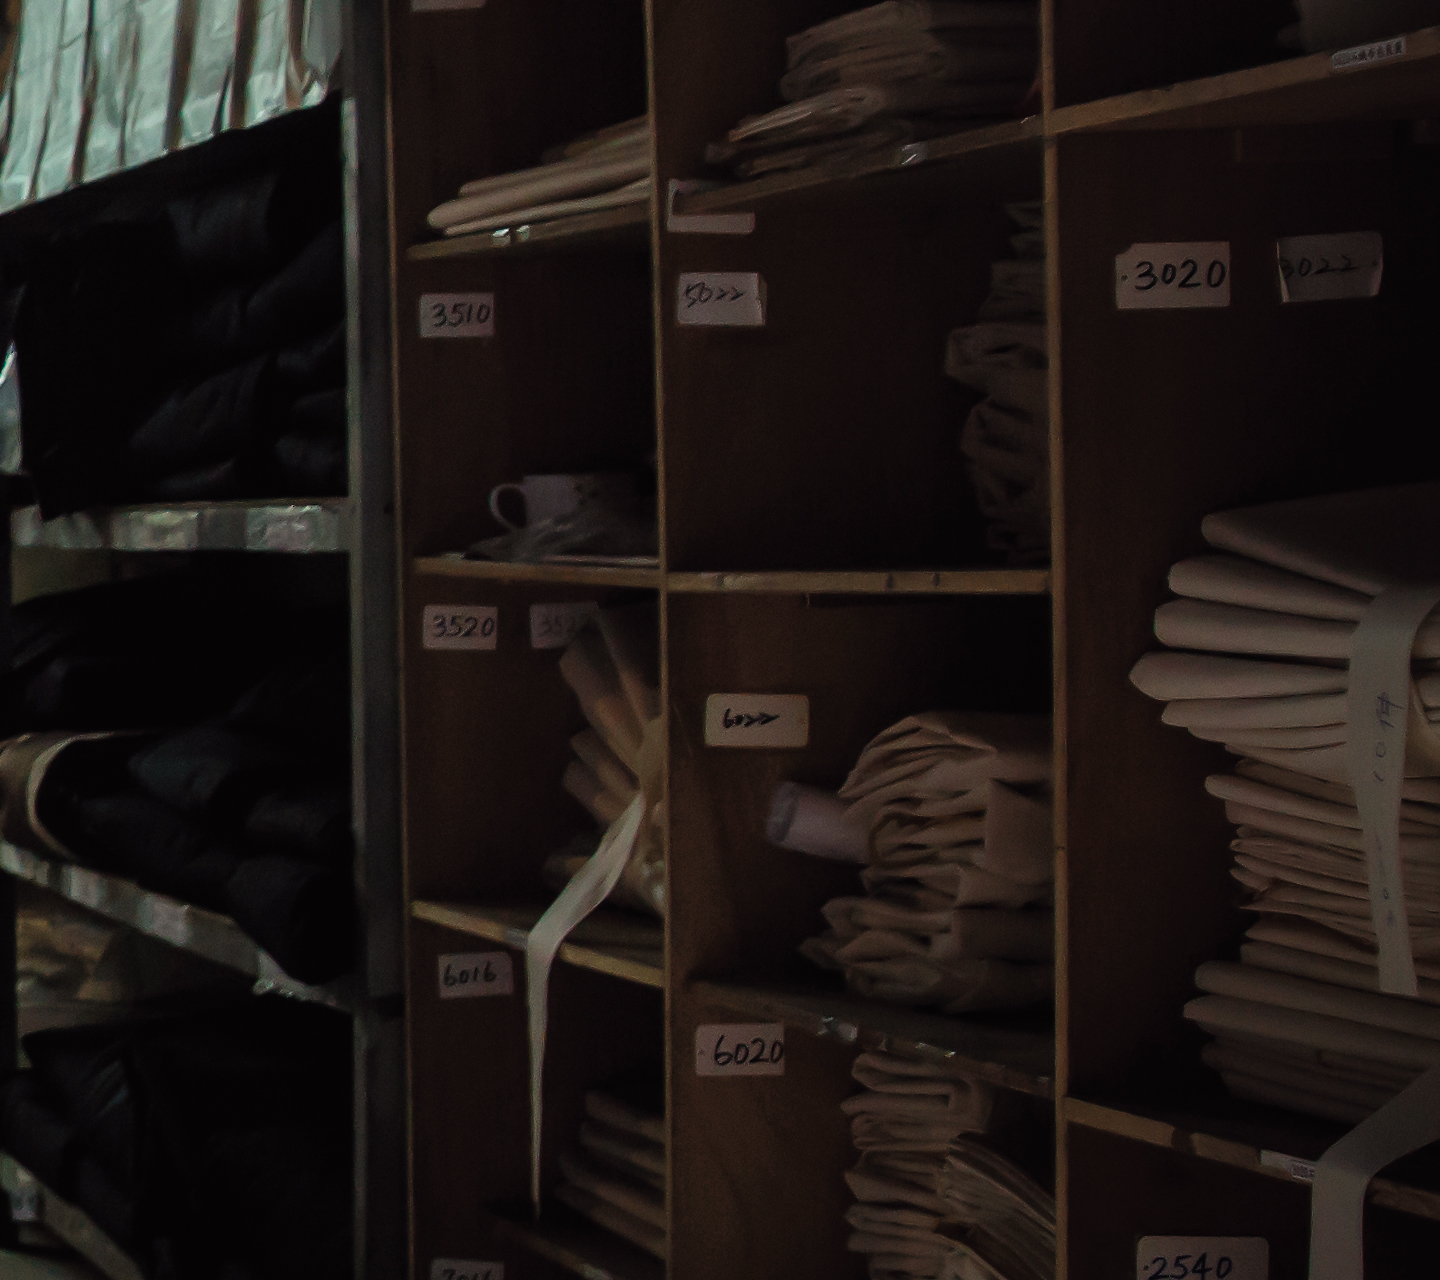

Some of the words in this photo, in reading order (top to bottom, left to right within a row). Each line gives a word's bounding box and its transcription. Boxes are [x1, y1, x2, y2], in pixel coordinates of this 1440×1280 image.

[1134, 258, 1228, 291] 3020
[432, 302, 491, 328] 3510
[432, 613, 495, 638] 3520
[443, 960, 497, 987] 6016
[714, 1034, 784, 1066] 6020
